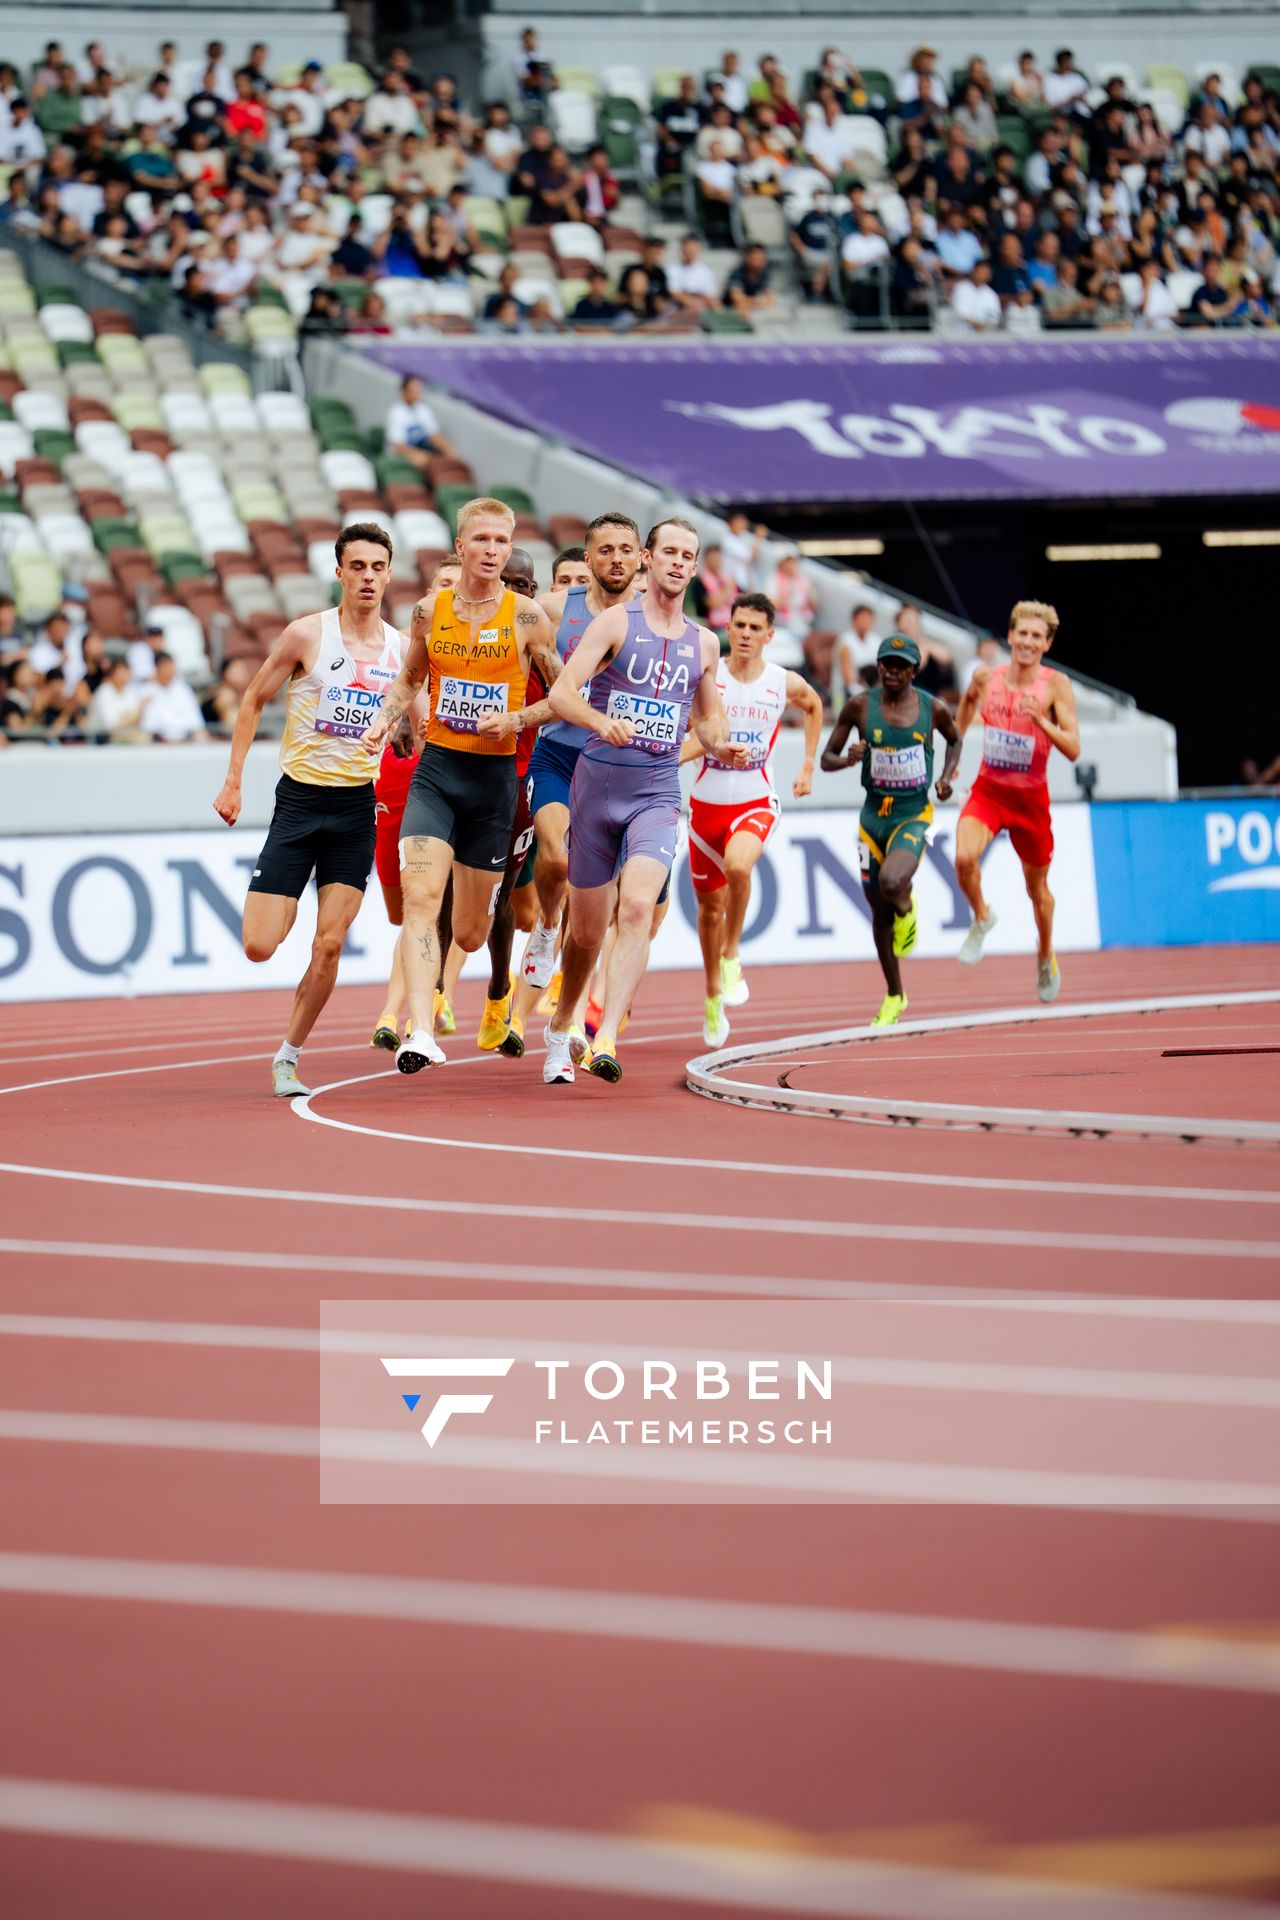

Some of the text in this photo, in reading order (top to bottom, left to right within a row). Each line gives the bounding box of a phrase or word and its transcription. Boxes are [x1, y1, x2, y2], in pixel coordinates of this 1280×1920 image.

[433, 640, 511, 658] GERMANY
[370, 669, 390, 678] Allianz
[627, 653, 690, 694] USA
[343, 688, 386, 708] TDK
[457, 681, 504, 701] TDK
[333, 706, 373, 726] SISK
[630, 697, 676, 720] TDK
[997, 732, 1029, 749] TDK
[886, 748, 920, 764] TDK
[1204, 810, 1280, 866] PO
[677, 832, 1008, 946] ONY
